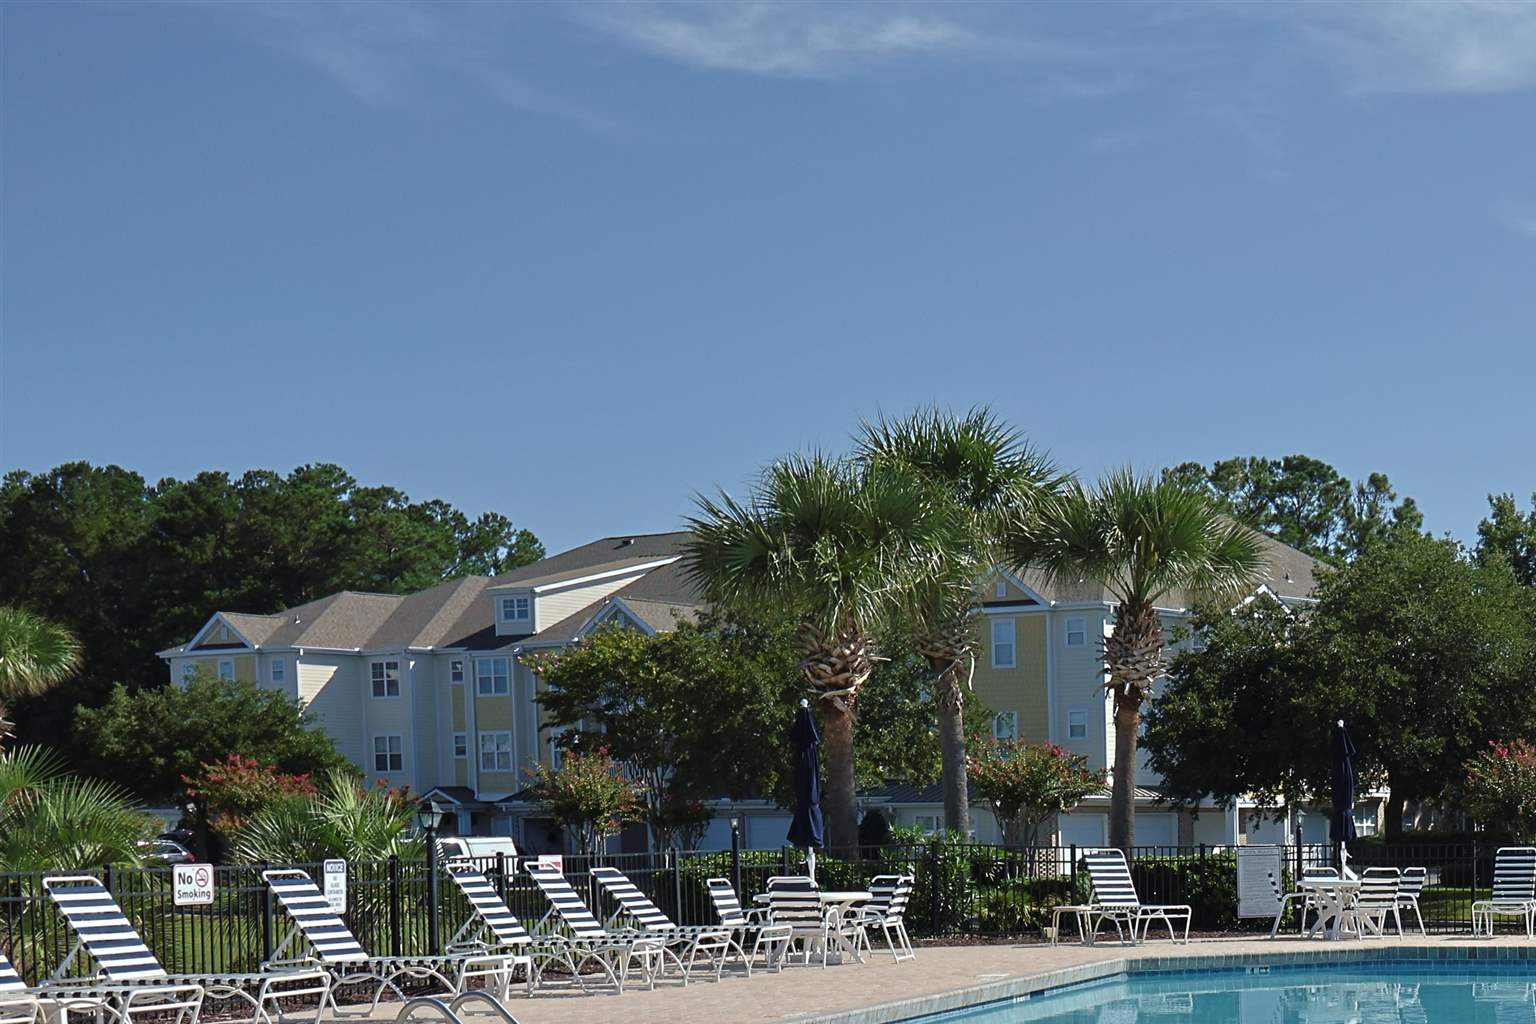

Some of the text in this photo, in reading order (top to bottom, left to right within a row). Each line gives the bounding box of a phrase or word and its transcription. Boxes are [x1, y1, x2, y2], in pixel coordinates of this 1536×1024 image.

[326, 863, 344, 872] NOTICE
[178, 872, 193, 885] No
[177, 889, 211, 900] Smoking
